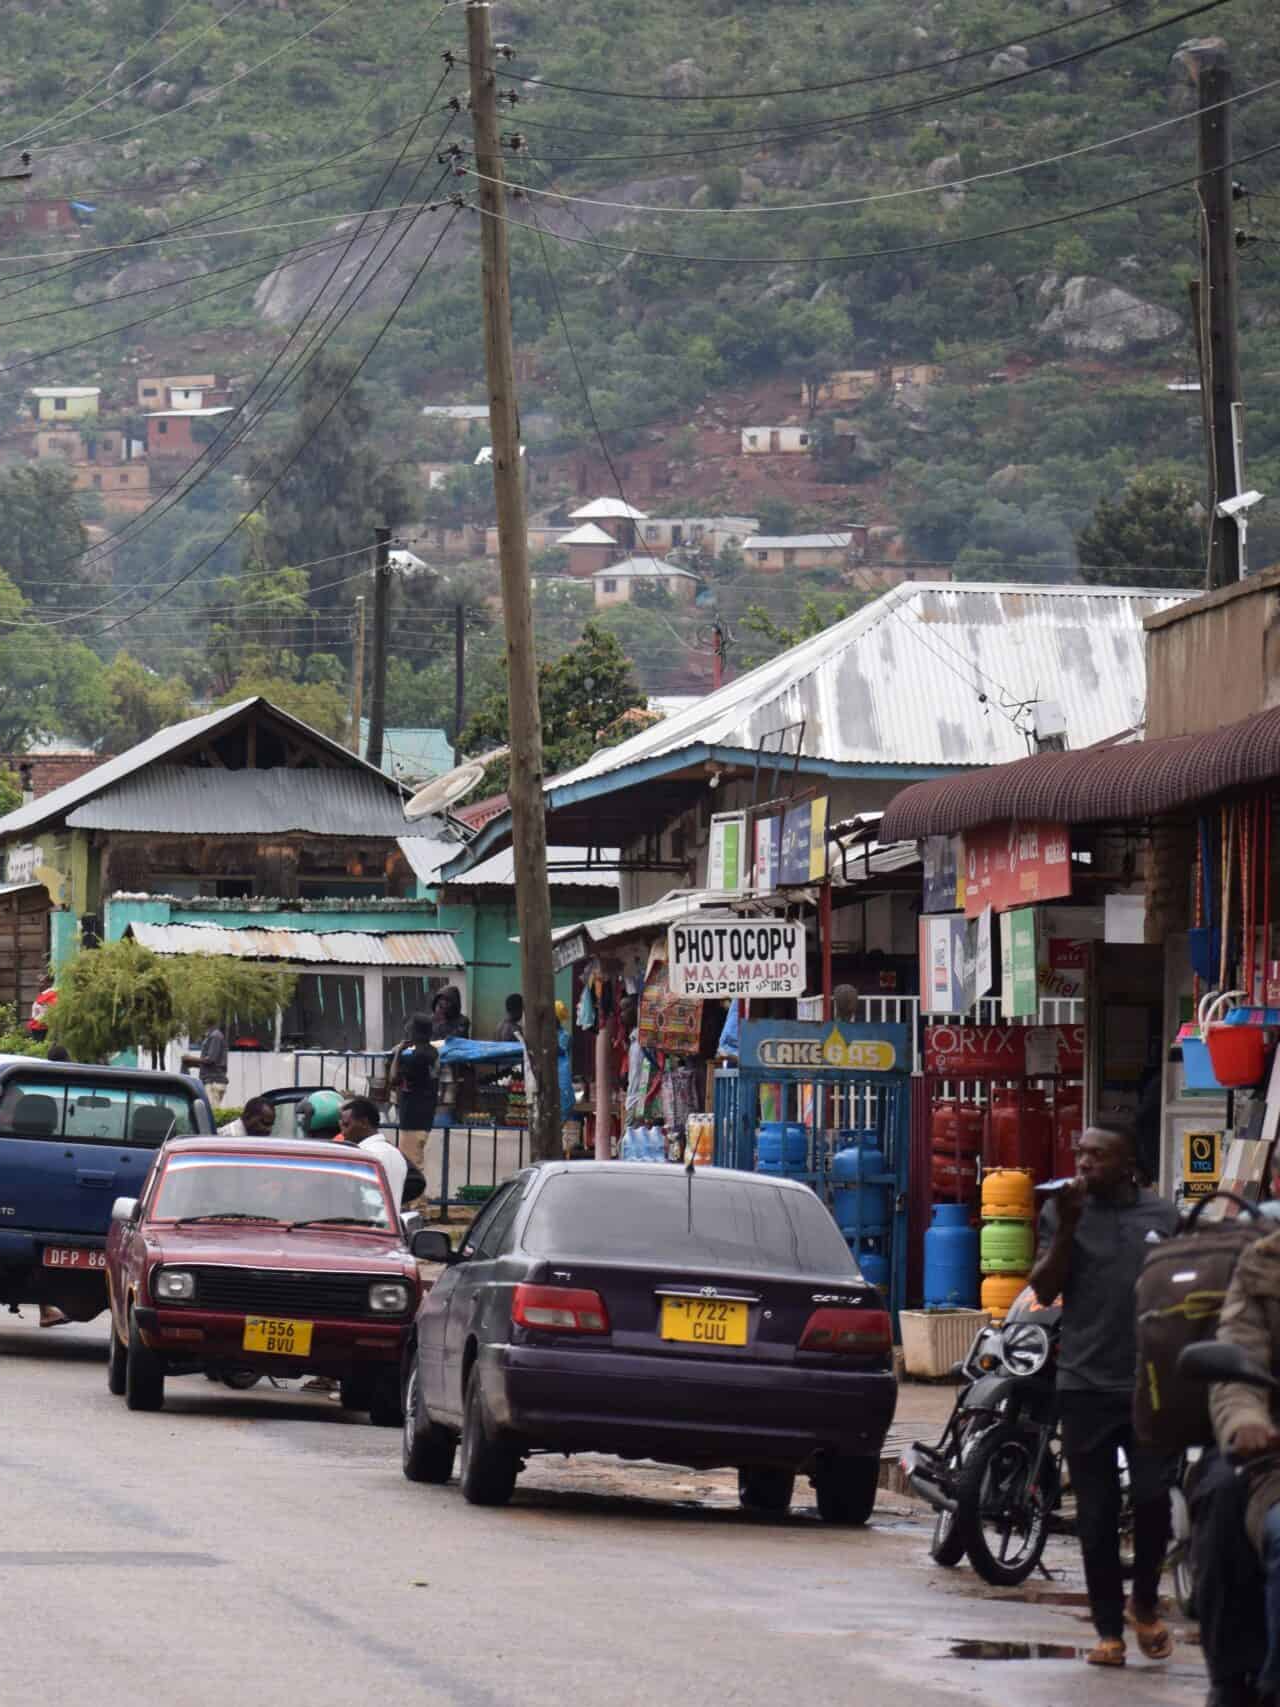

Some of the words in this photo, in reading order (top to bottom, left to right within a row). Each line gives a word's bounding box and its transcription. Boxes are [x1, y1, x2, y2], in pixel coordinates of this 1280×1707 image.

[674, 928, 796, 964] PHOTOCOPY
[931, 1028, 1014, 1055] ORYX
[762, 1042, 821, 1064] LAKE
[828, 1044, 881, 1065] GAS
[50, 1249, 80, 1265] DFP
[260, 1320, 295, 1337] T556
[693, 1322, 727, 1342] CUU
[267, 1337, 295, 1353] BVU
